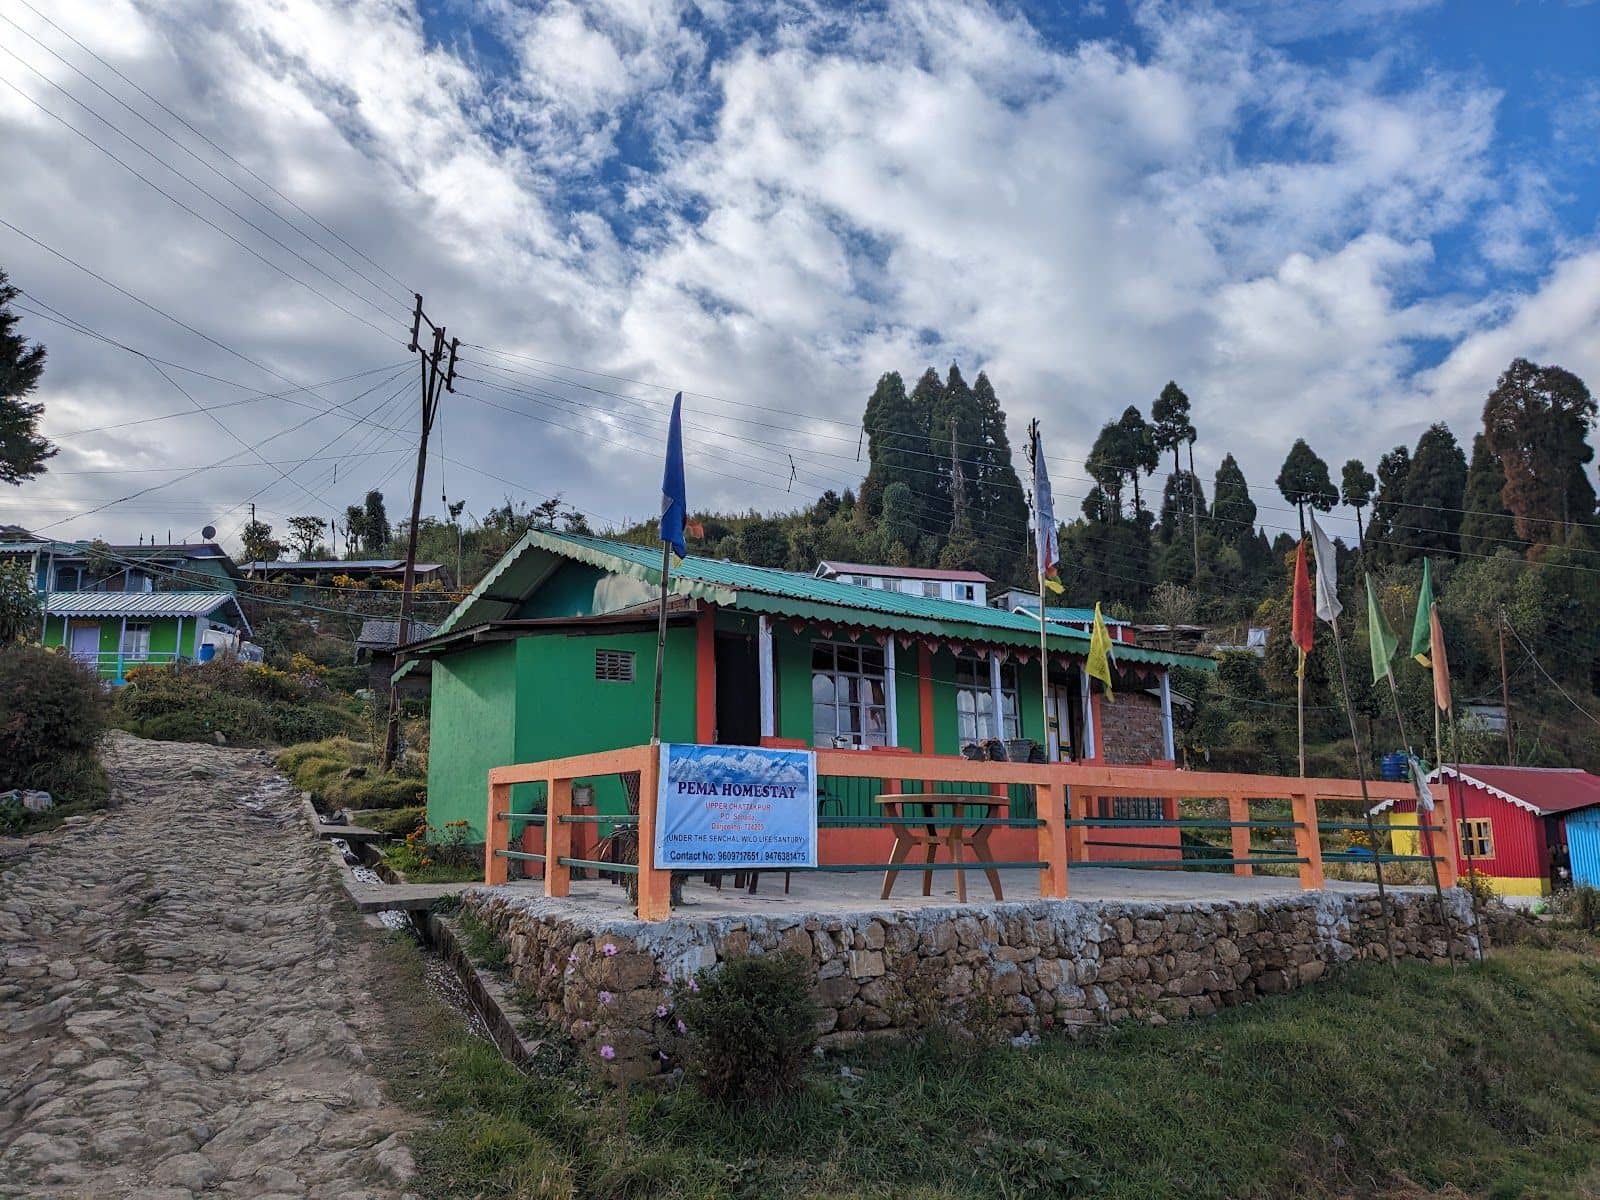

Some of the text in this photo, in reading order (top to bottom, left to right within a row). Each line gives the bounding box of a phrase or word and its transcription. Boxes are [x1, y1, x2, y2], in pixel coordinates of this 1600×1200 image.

[677, 781, 797, 799] PEMA HOMESTAY
[705, 802, 728, 810] UPPER
[693, 834, 708, 842] THE
[670, 850, 701, 861] Contact
